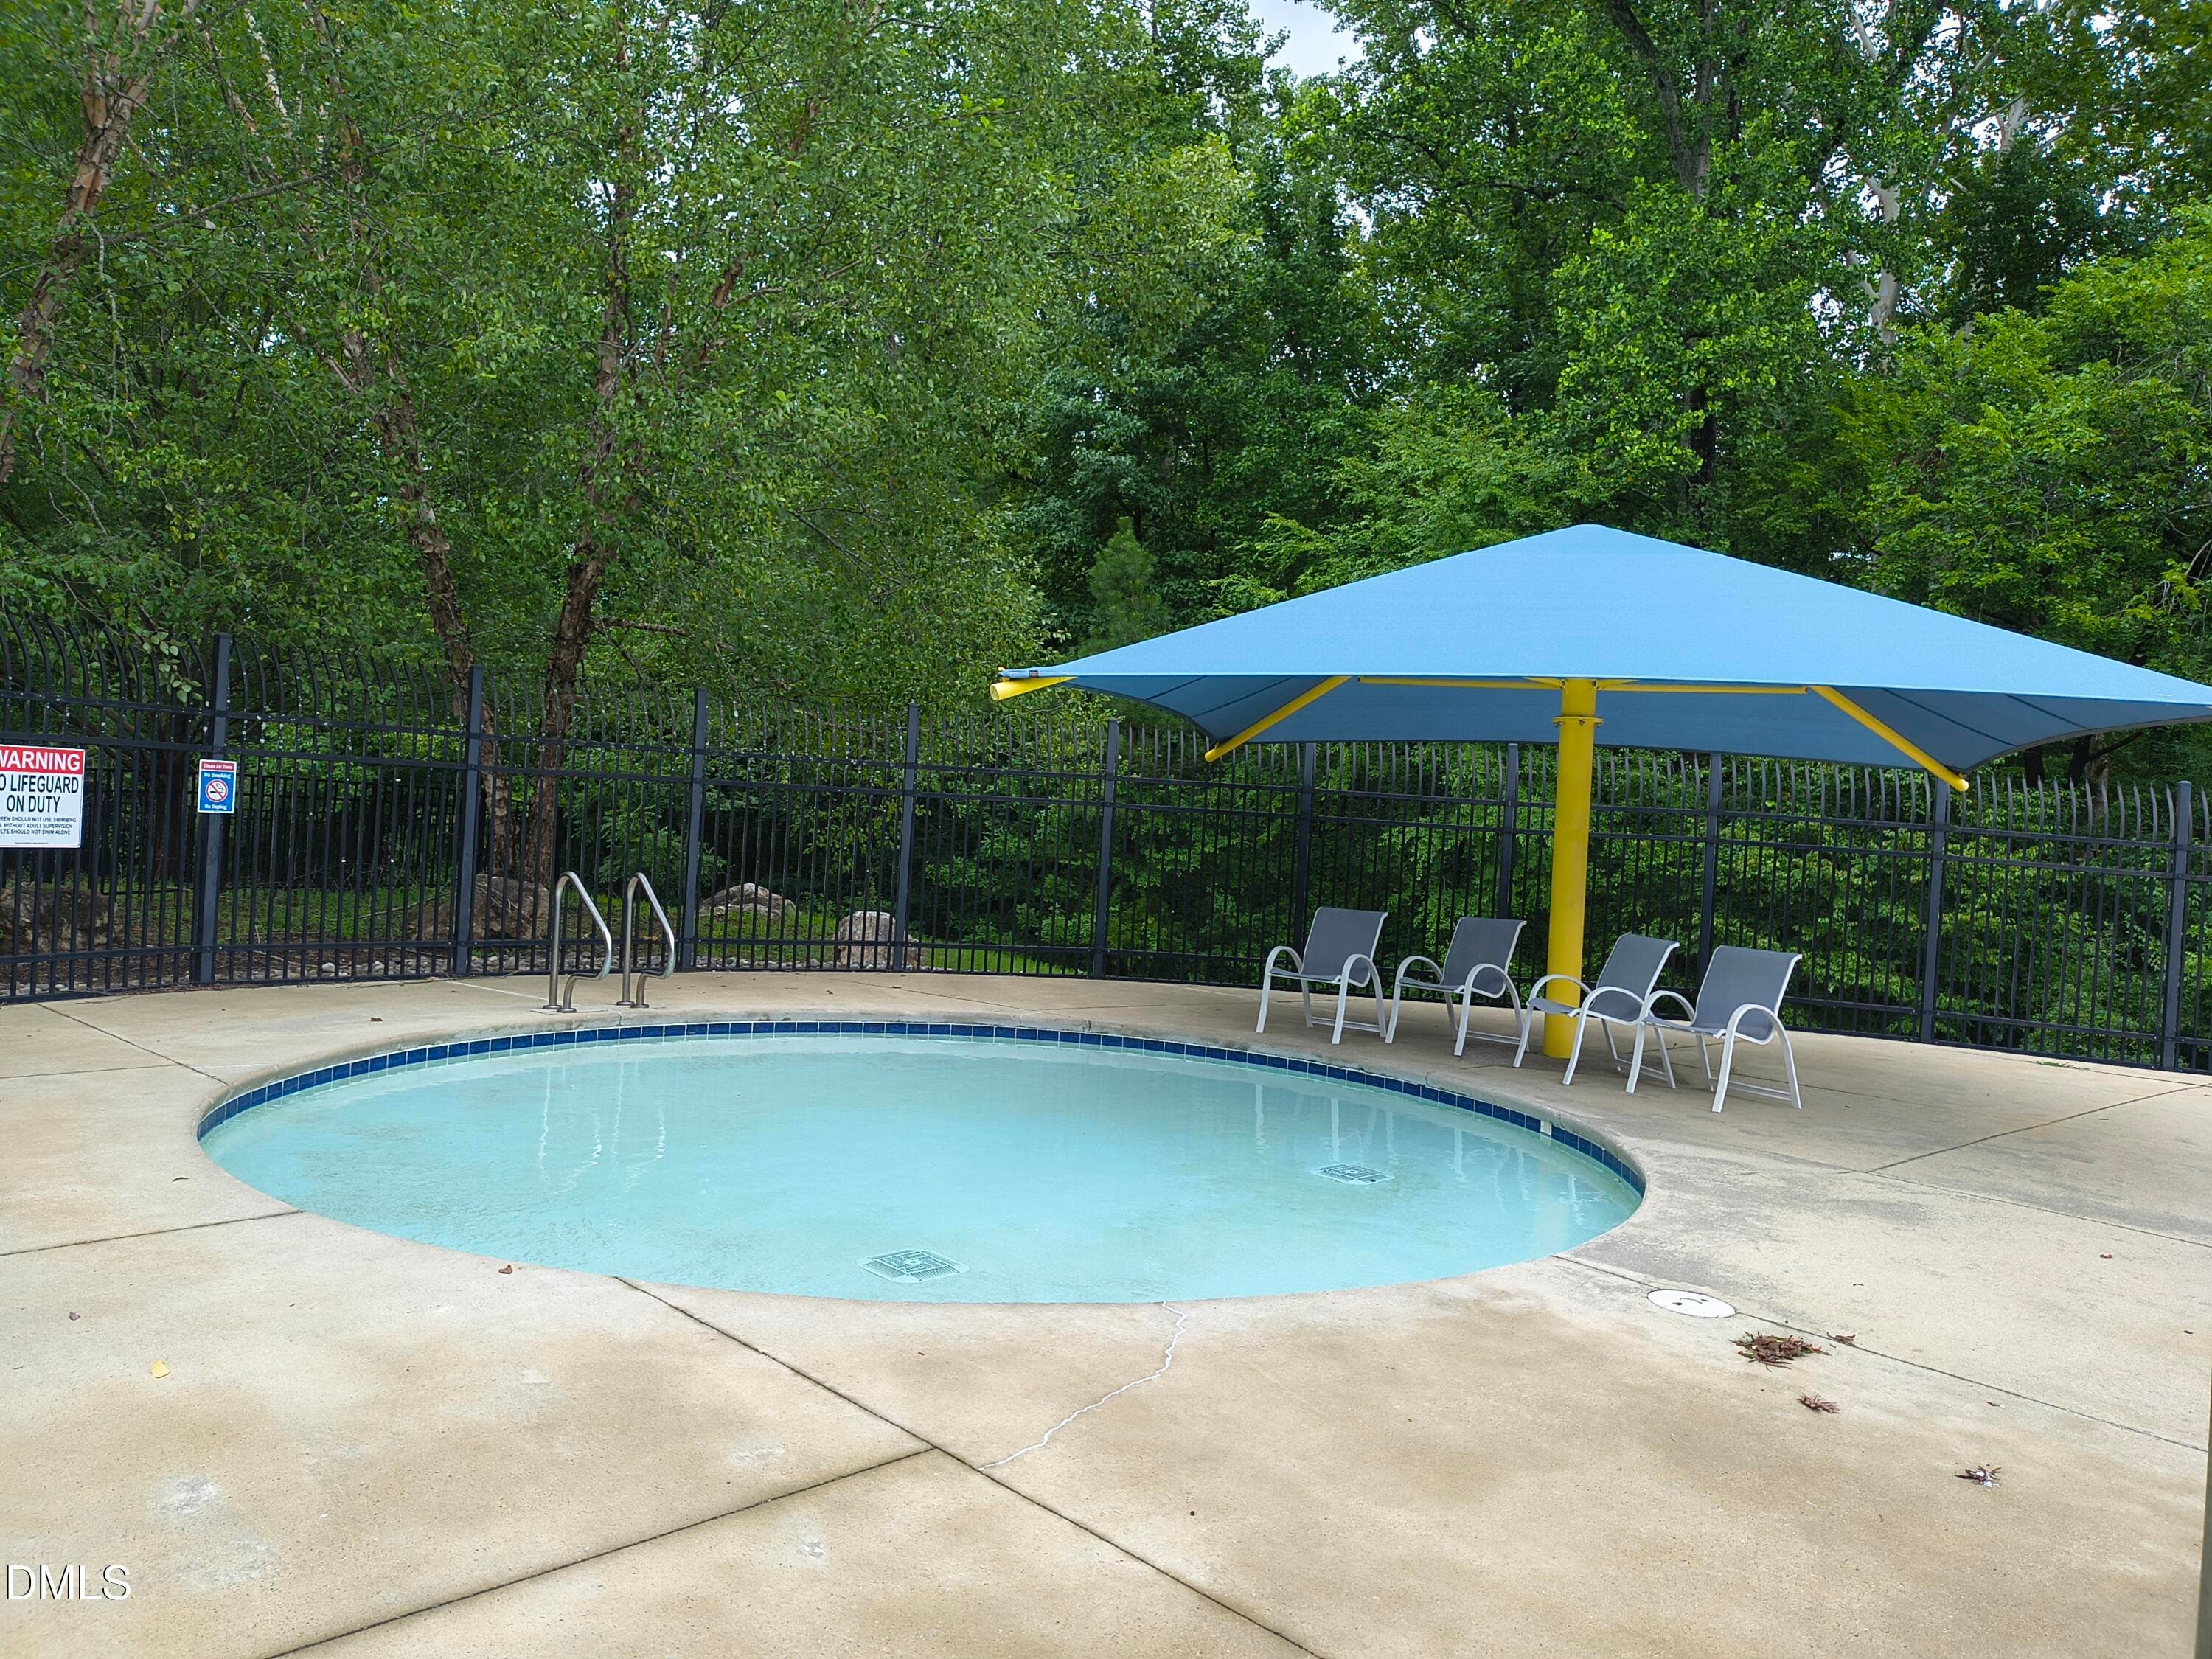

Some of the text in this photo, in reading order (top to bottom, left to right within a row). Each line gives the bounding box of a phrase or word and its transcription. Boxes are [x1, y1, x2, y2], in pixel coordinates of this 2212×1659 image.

[10, 774, 79, 793] LIFEGUARD
[7, 795, 60, 813] ON DUTY
